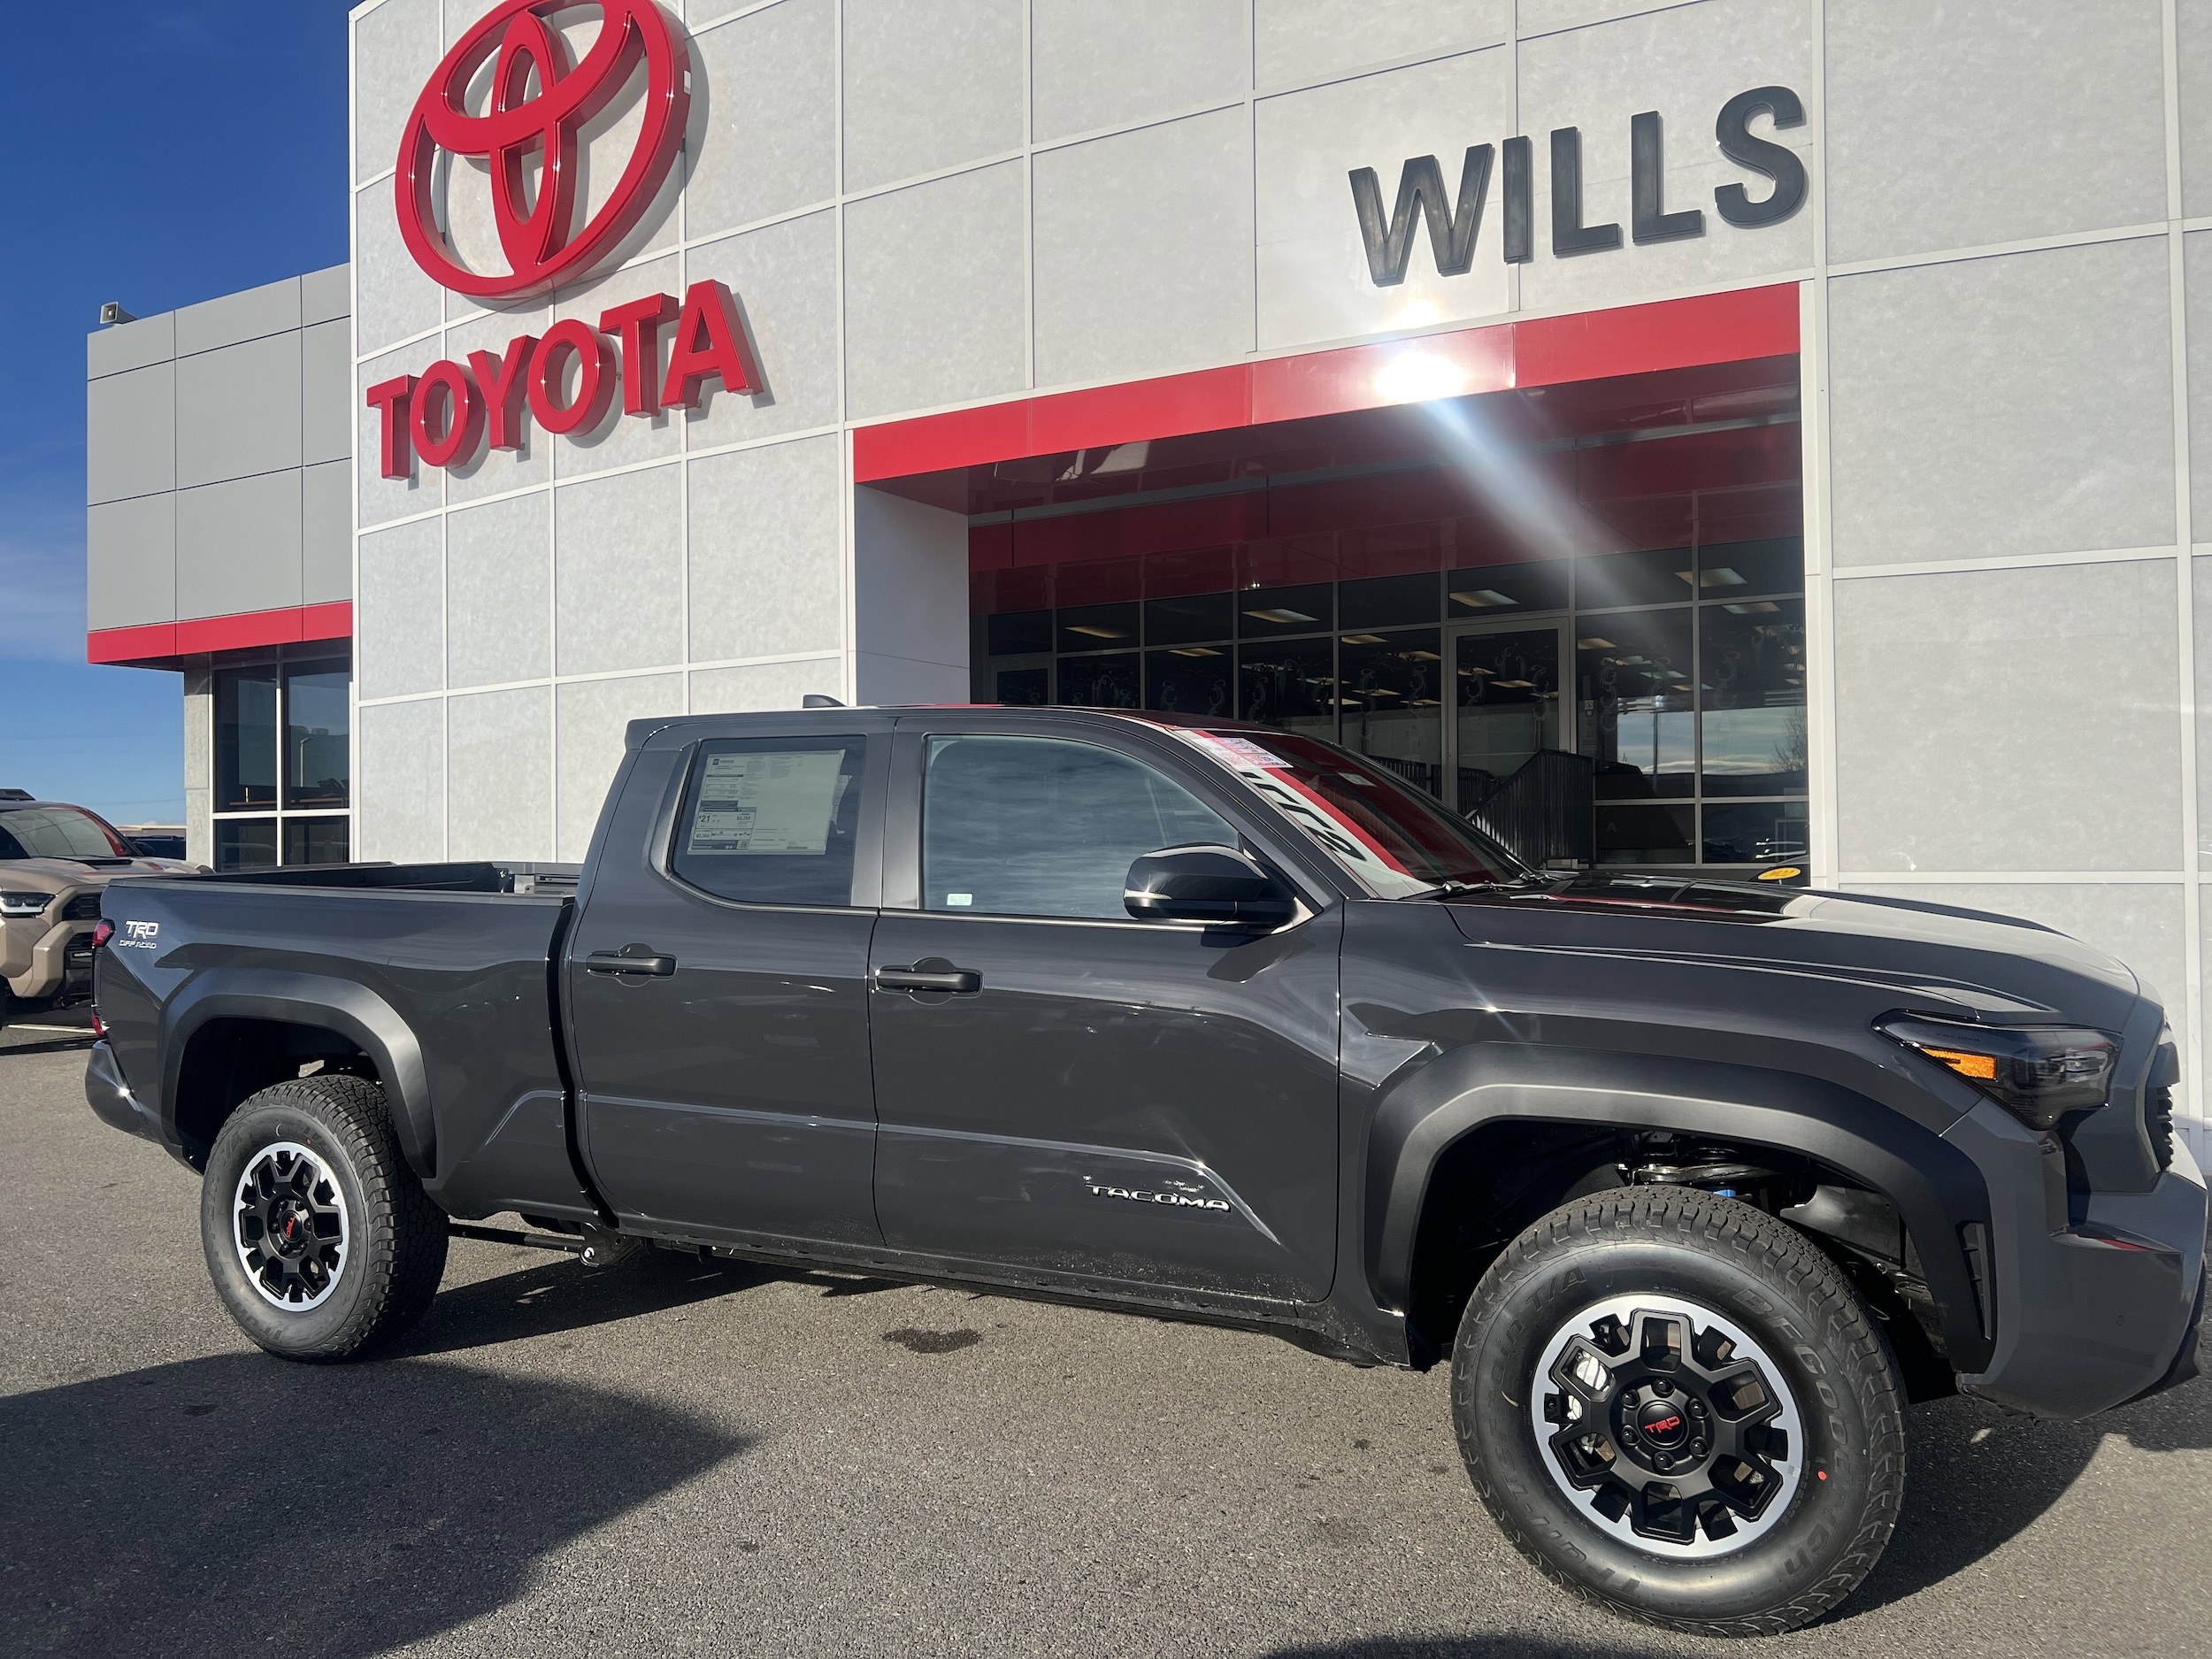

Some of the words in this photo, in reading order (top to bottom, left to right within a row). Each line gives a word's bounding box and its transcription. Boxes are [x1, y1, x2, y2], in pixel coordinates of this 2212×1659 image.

[1348, 86, 1808, 288] WILLS
[366, 279, 764, 480] TOYOTA
[125, 920, 159, 940] TRD
[1085, 1182, 1232, 1213] TACOMA
[1525, 1265, 1587, 1313] T/A
[1644, 1416, 1680, 1433] TRD
